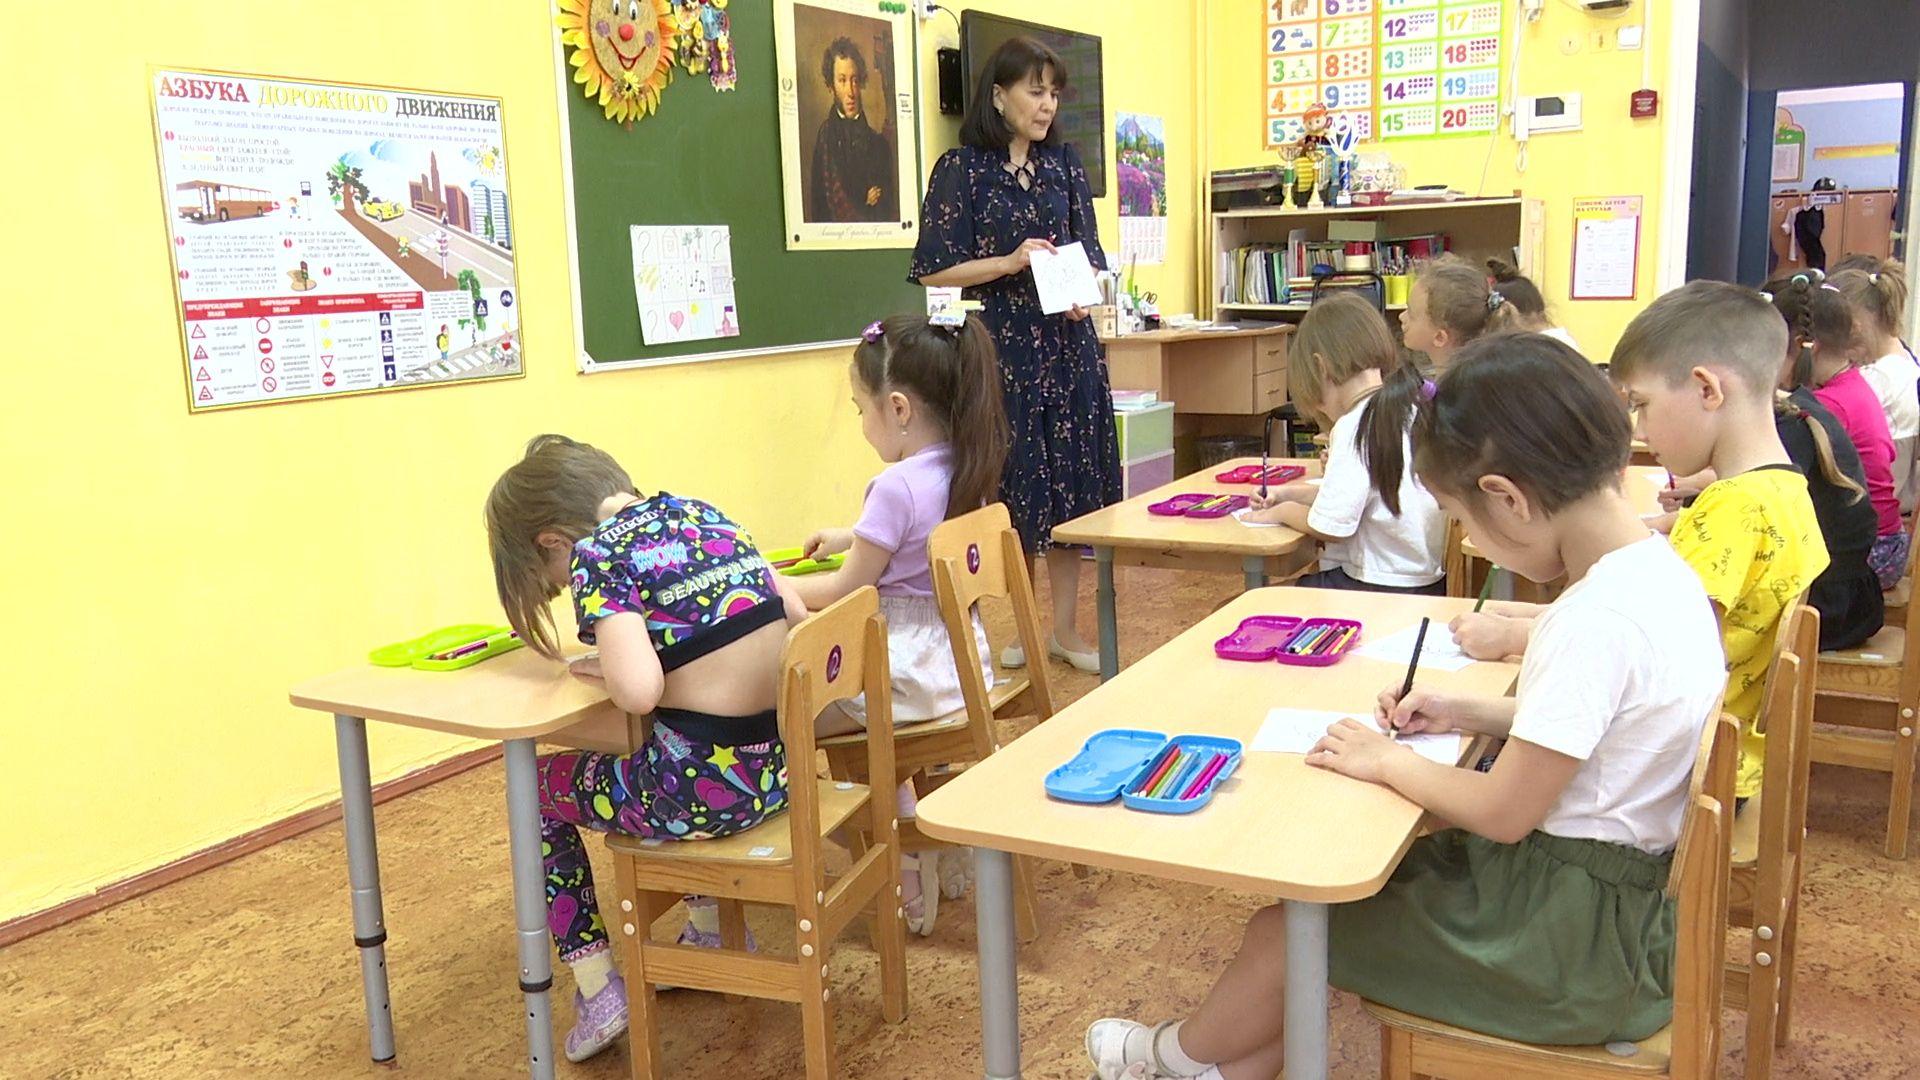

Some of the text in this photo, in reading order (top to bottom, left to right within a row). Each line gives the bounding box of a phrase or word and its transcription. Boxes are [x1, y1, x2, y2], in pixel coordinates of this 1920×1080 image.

[1384, 18, 1406, 38] 12
[1446, 10, 1470, 31] 17
[1271, 29, 1286, 52] 2
[1325, 23, 1340, 46] 7
[1384, 50, 1404, 69] 13
[1444, 44, 1467, 64] 18
[1272, 60, 1285, 82] 3
[1325, 54, 1339, 77] 8
[1325, 85, 1340, 108] 9
[1383, 81, 1406, 100] 14
[1443, 77, 1466, 96] 19
[159, 76, 497, 122] АЗБУКА ДОРОЖНОГО ДВИЖЕНИЯ
[1271, 90, 1286, 112] 4
[1383, 113, 1404, 132] 15
[1442, 109, 1467, 128] 20
[1272, 120, 1286, 143] 5
[598, 511, 659, 544] queen
